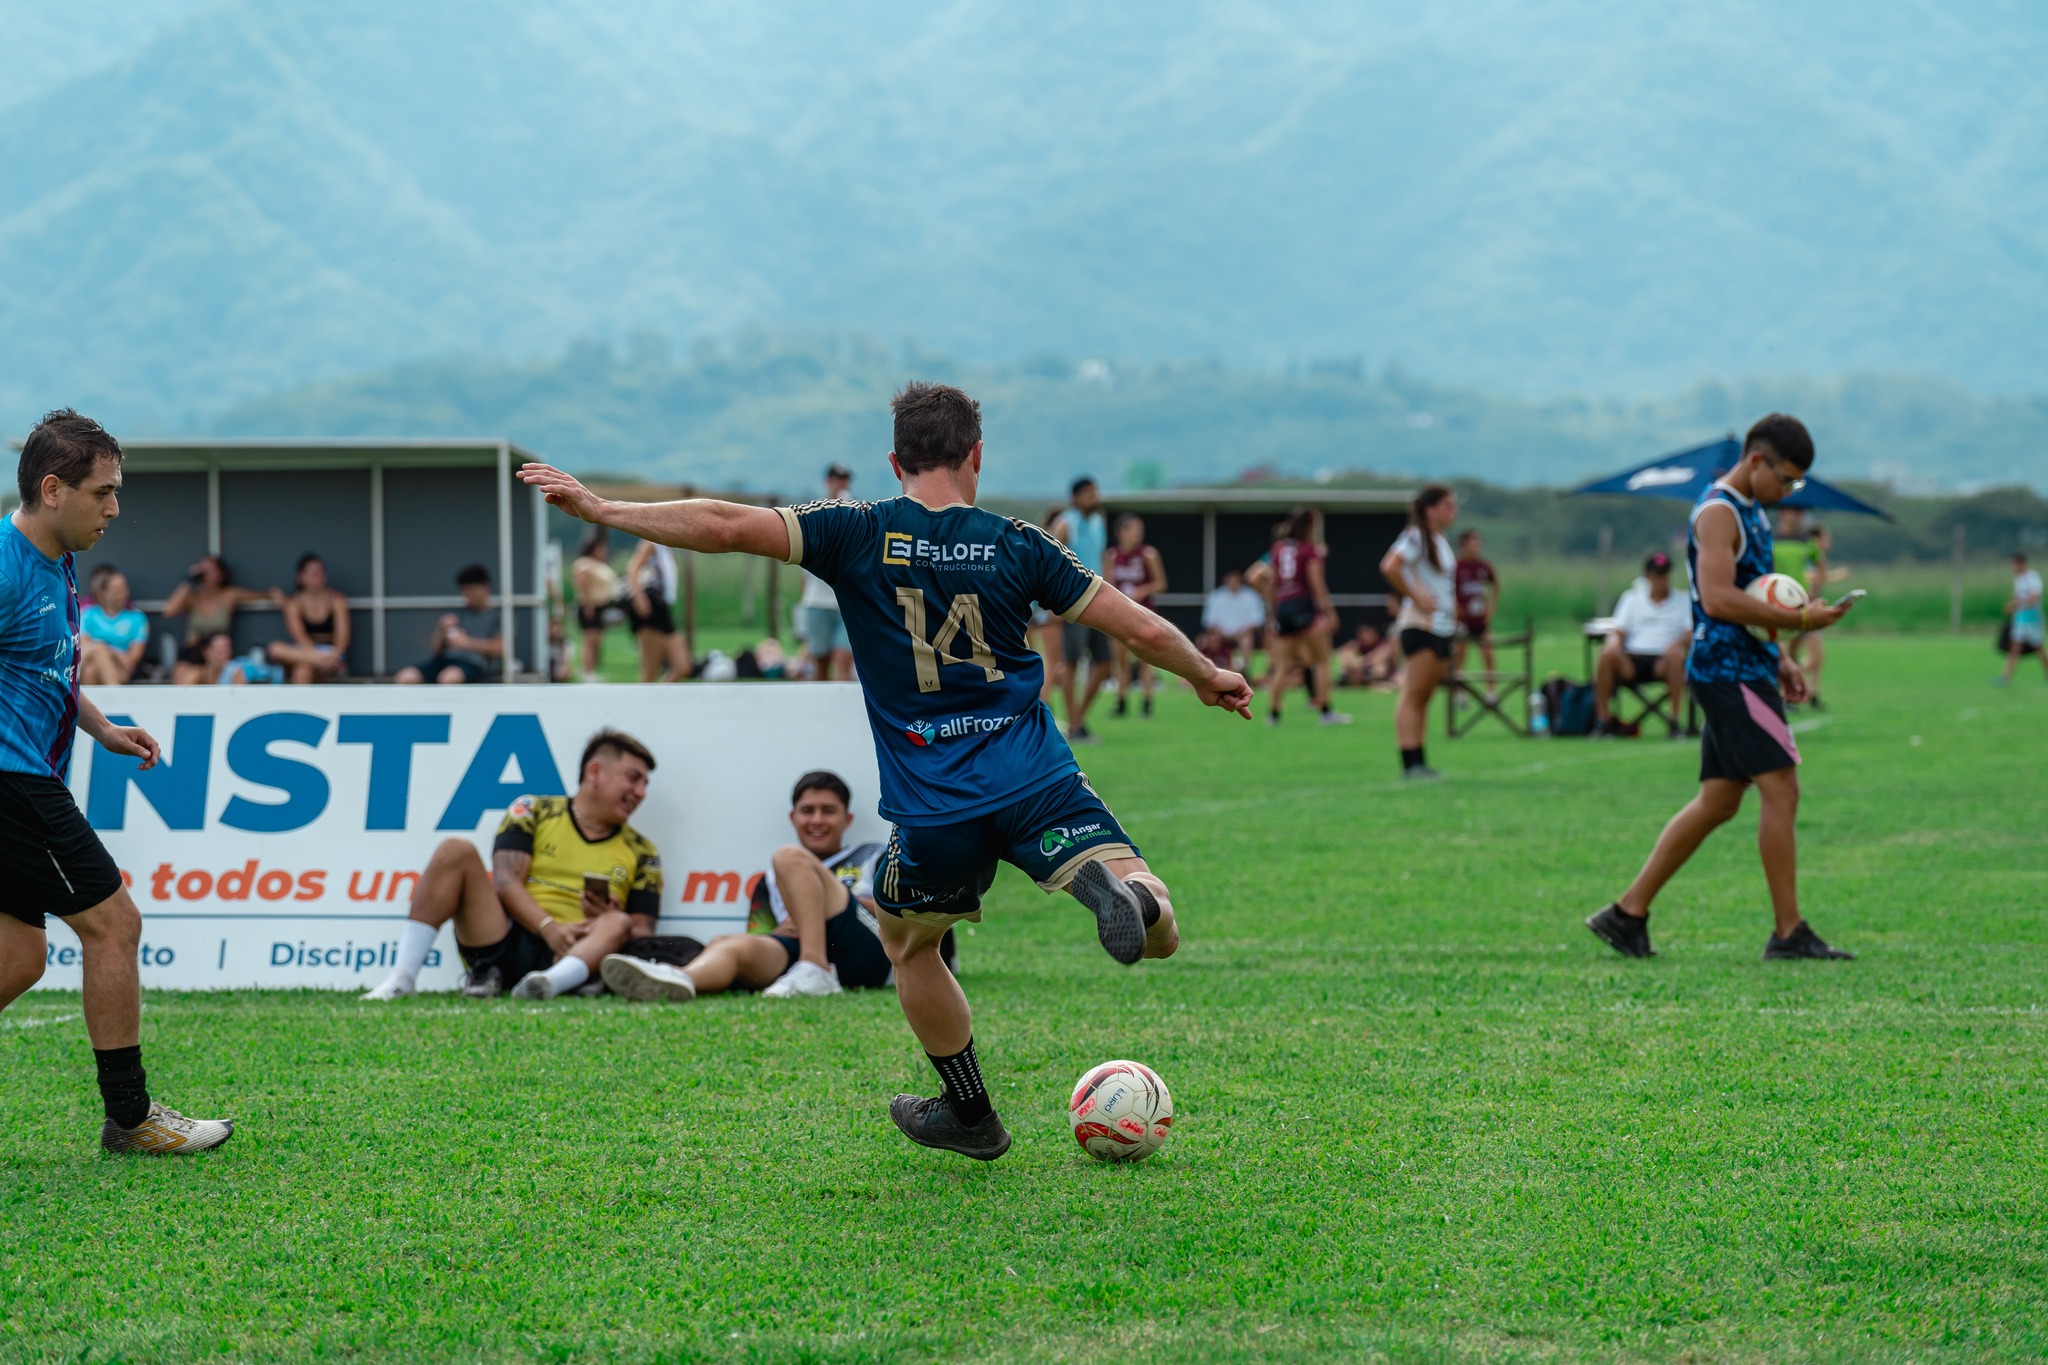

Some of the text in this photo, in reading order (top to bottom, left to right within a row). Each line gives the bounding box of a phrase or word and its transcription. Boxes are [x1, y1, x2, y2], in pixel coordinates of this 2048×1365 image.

[916, 539, 996, 562] EGLOFF
[896, 587, 1005, 693] 14
[1071, 823, 1101, 837] Angar
[1074, 829, 1112, 843] Farmacia
[151, 858, 328, 902] todos
[270, 940, 442, 973] Disciplia
